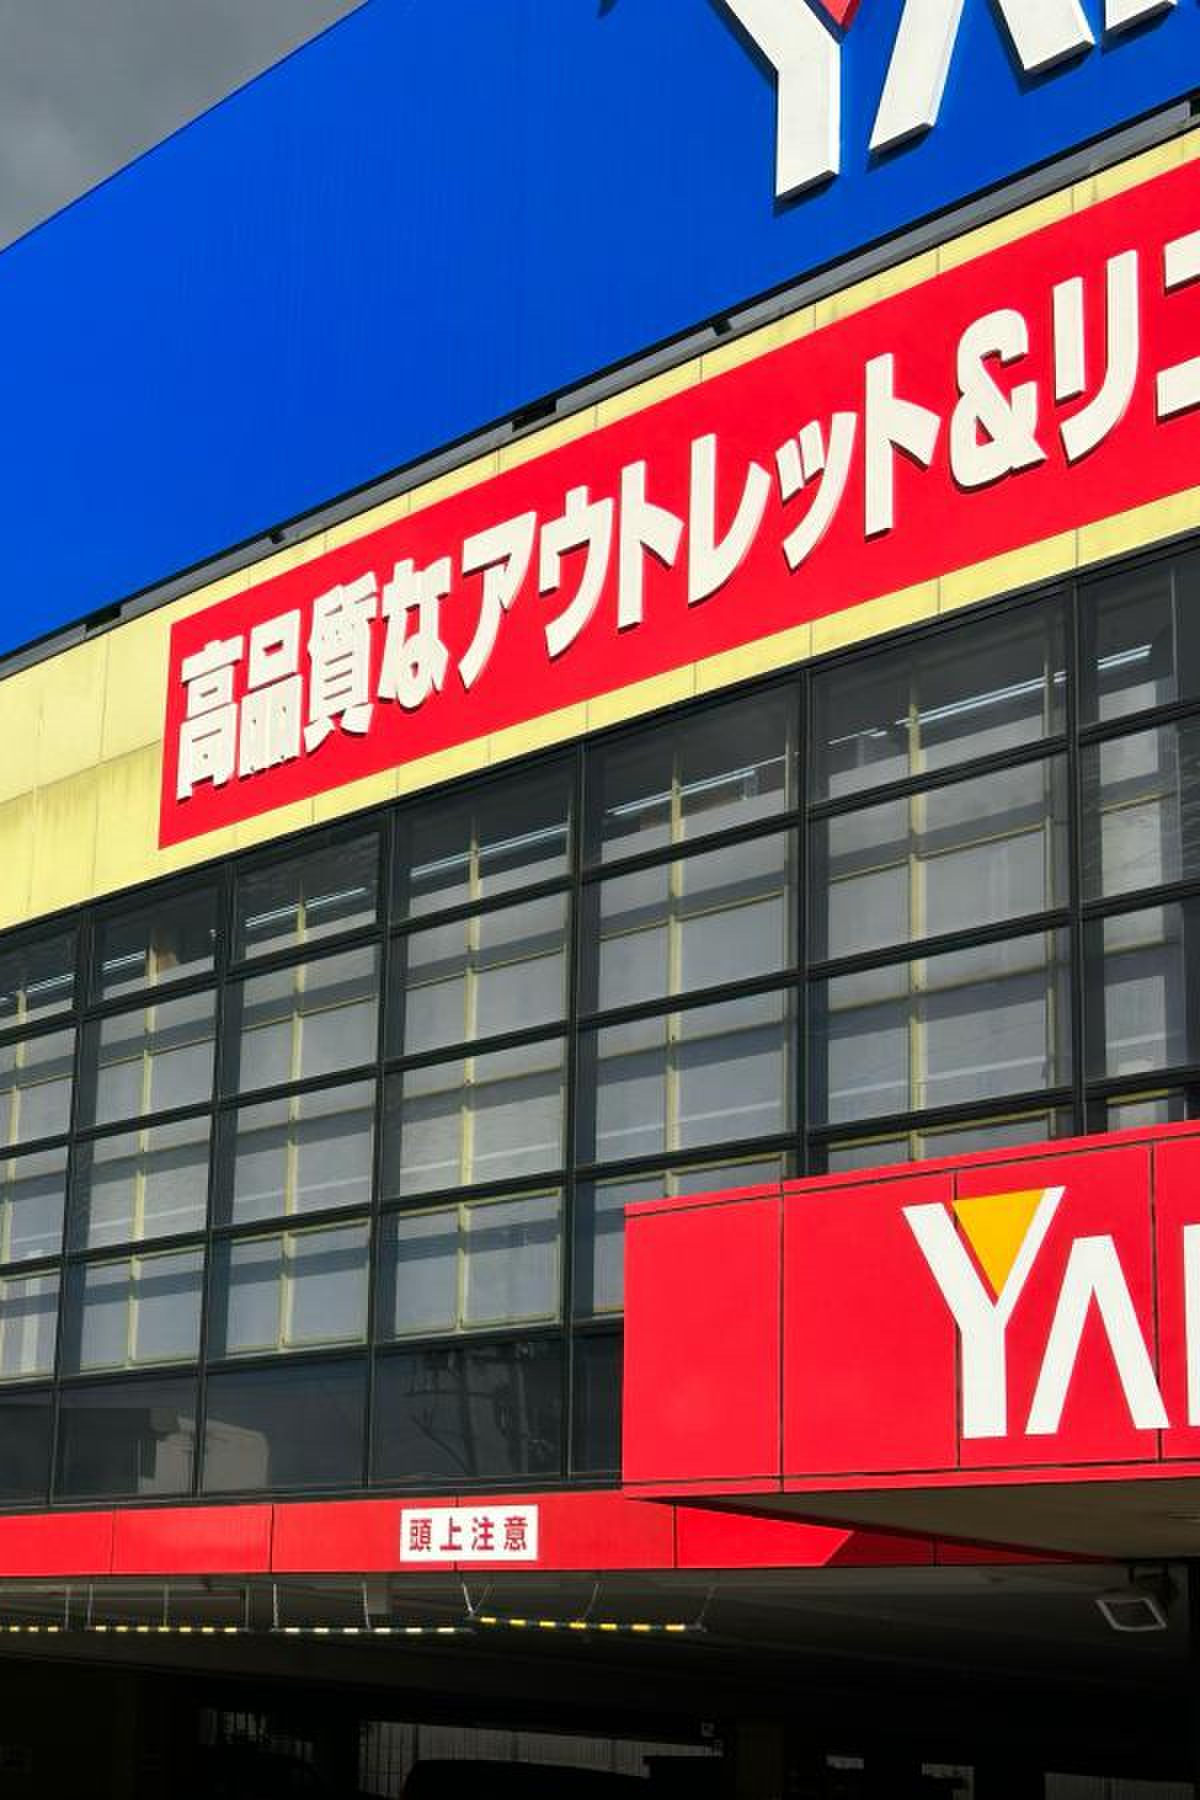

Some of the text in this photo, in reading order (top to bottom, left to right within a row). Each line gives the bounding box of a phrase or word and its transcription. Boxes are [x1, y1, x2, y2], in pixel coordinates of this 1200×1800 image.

[901, 1186, 1200, 1439] YA
[409, 1515, 528, 1552] 頭上注意
